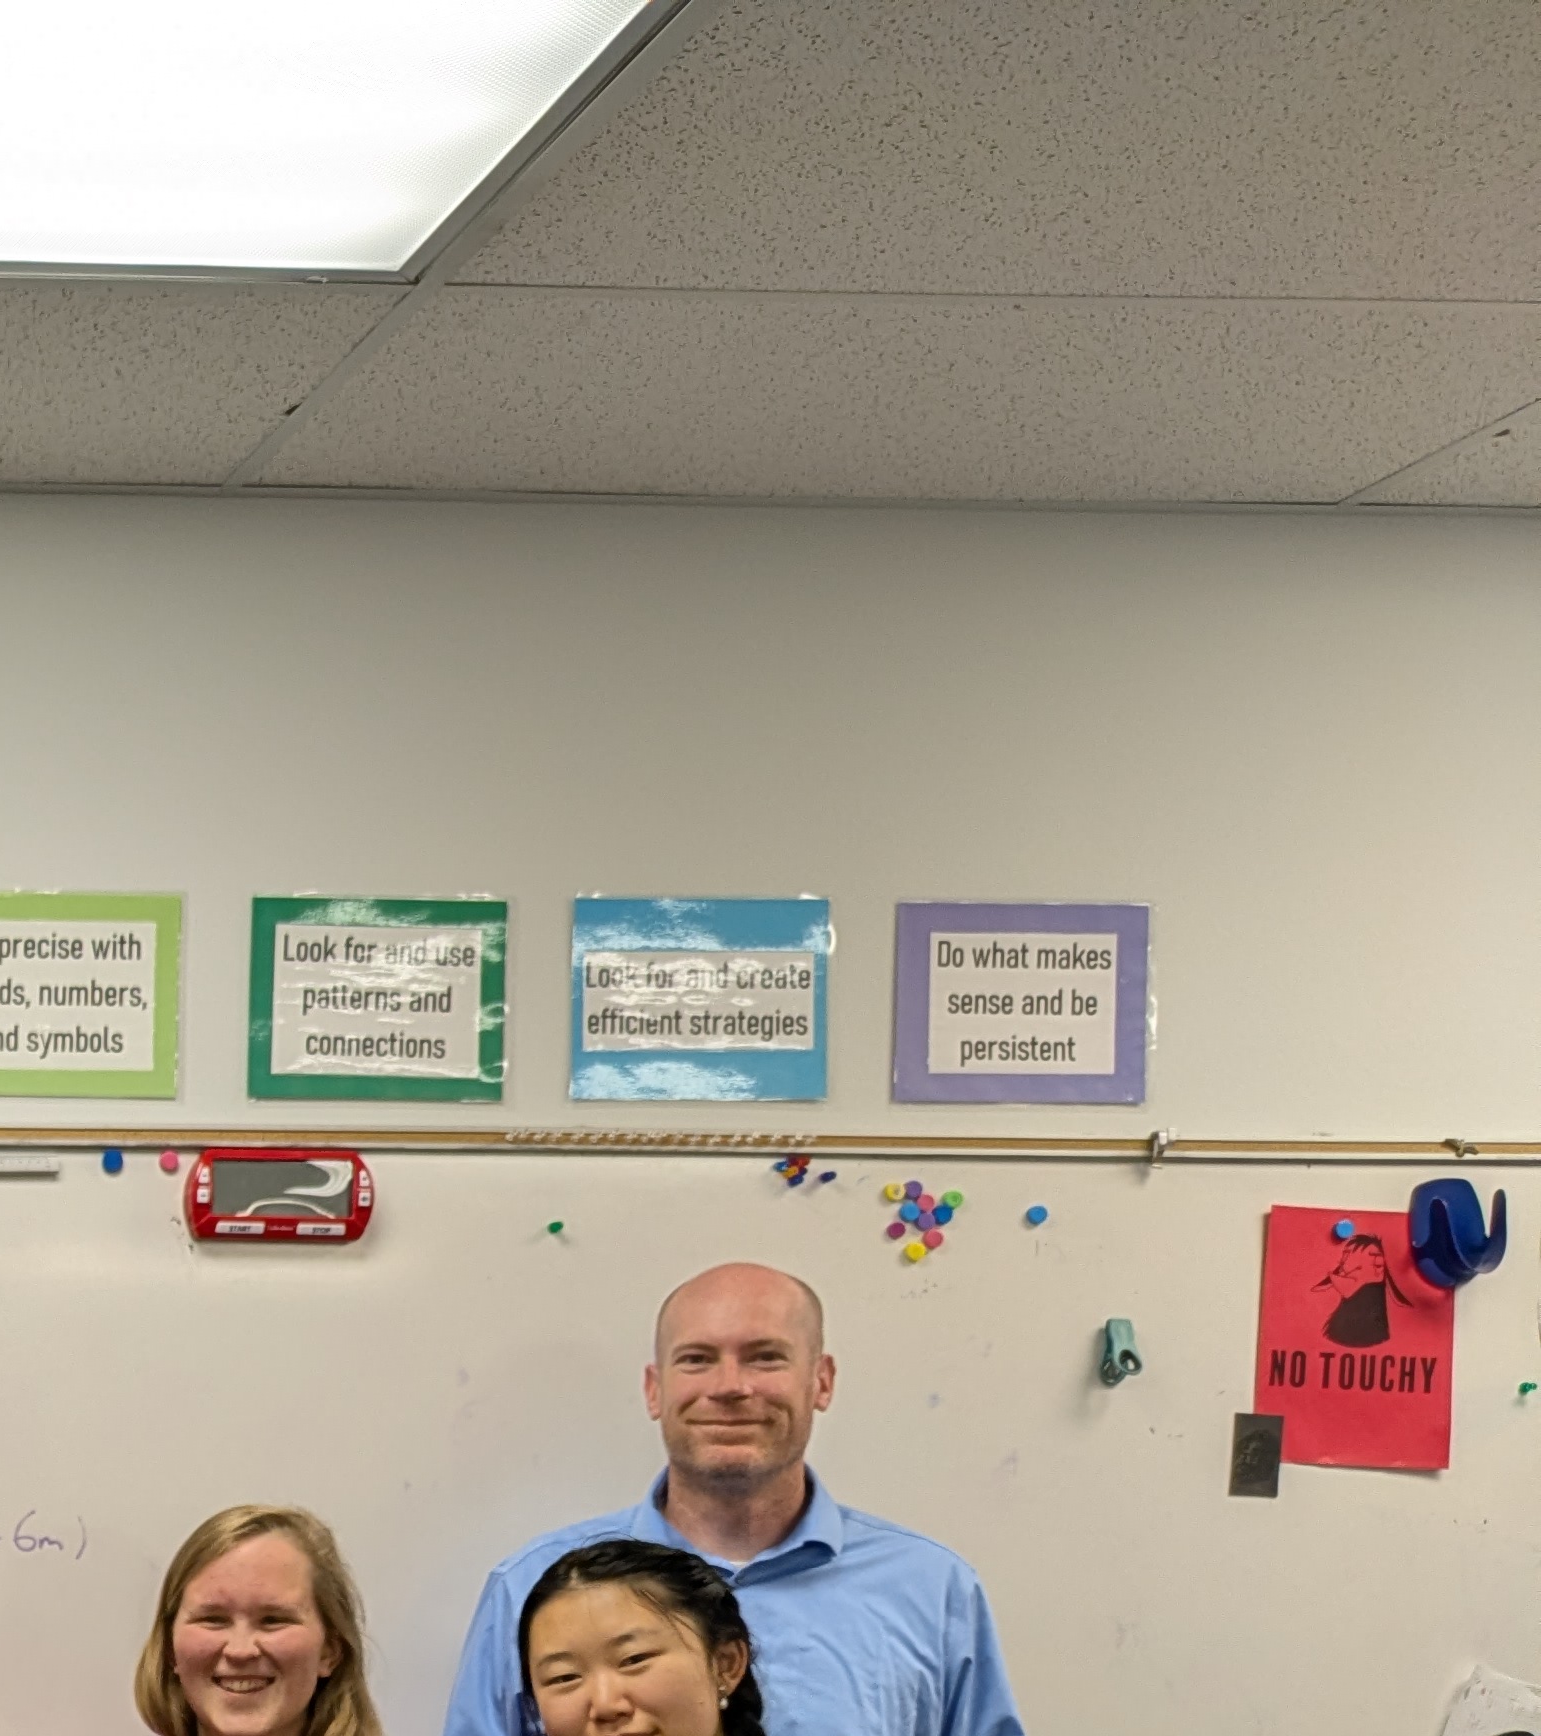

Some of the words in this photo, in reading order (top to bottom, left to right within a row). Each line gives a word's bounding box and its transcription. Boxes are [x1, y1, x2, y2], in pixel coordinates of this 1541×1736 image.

[91, 932, 142, 960] with
[282, 935, 338, 964] Look
[343, 936, 378, 964] for
[385, 939, 428, 966] and
[434, 944, 475, 967] use
[937, 941, 965, 968] Do
[972, 941, 1029, 968] what
[1037, 942, 1112, 970] makes
[585, 963, 639, 990] Look
[645, 962, 675, 990] for
[686, 962, 728, 990] and
[735, 964, 812, 991] create
[38, 980, 147, 1012] numbers,
[301, 985, 402, 1017] patterns
[408, 986, 452, 1014] and
[947, 993, 1013, 1016] sense
[1021, 989, 1065, 1016] and
[1071, 990, 1098, 1017] be
[587, 1008, 683, 1036] efficient
[689, 1010, 809, 1042] strategies
[26, 1026, 124, 1060] symbols
[305, 1030, 446, 1060] connections
[959, 1035, 1077, 1068] persistent
[1268, 1350, 1306, 1387] NO
[1320, 1353, 1437, 1393] TOUCHY
